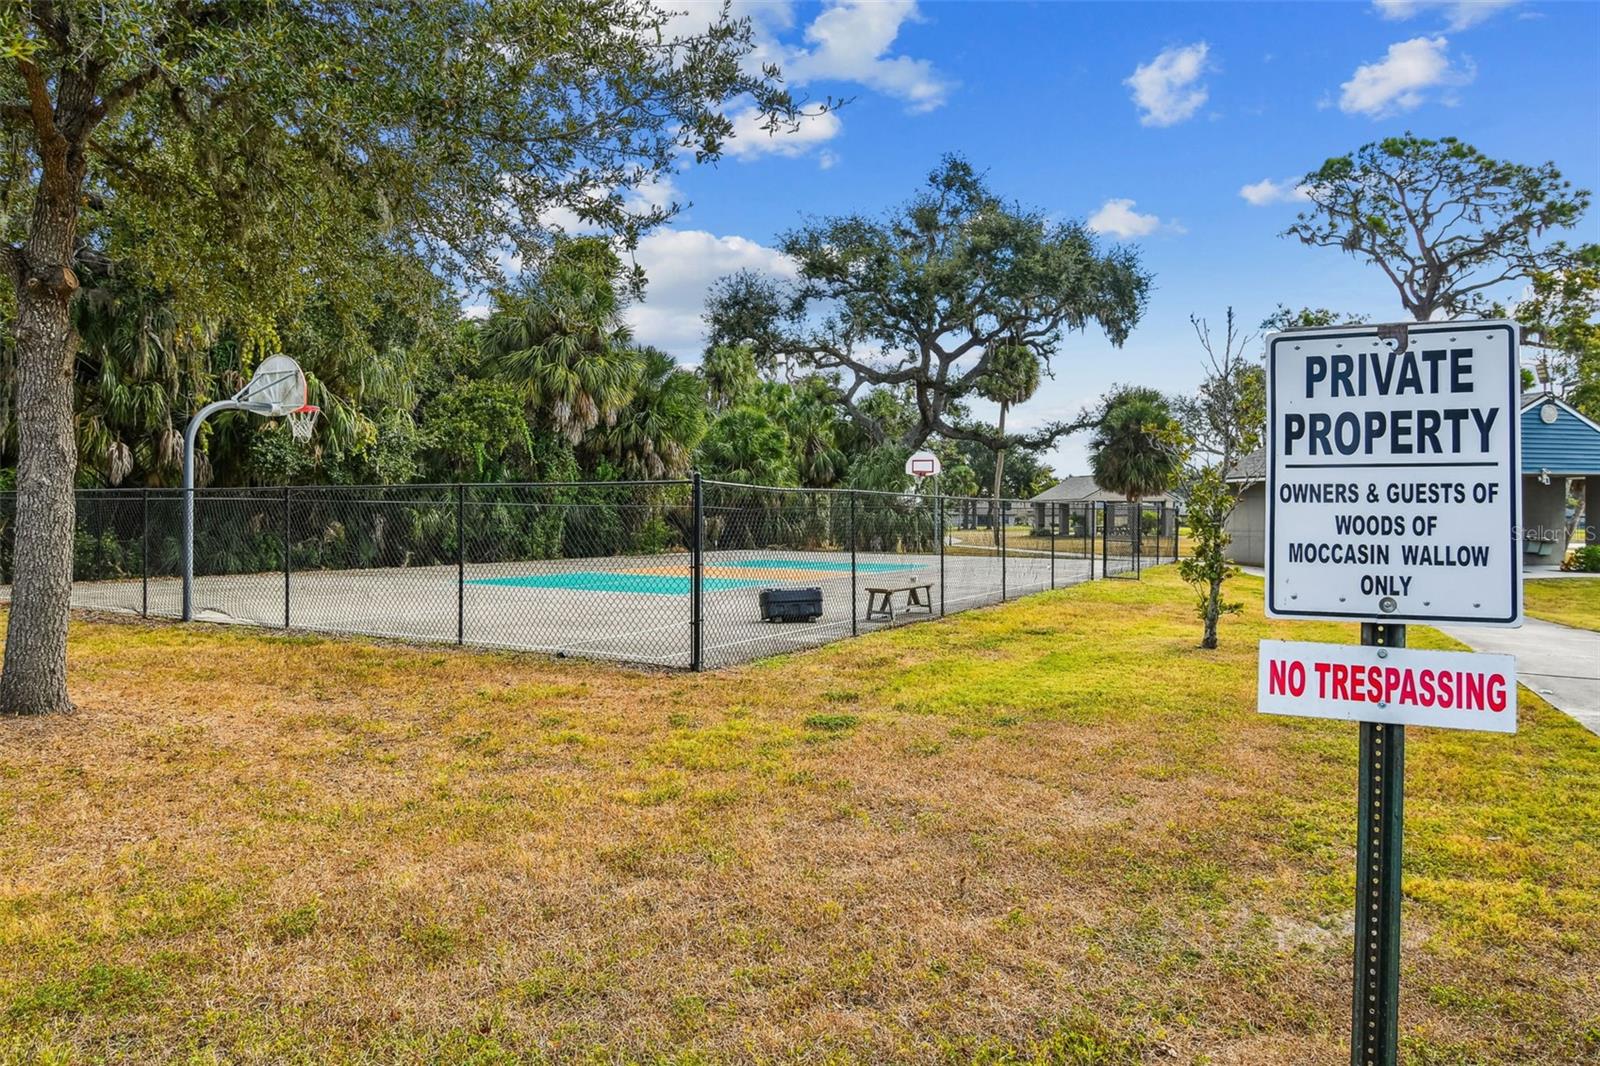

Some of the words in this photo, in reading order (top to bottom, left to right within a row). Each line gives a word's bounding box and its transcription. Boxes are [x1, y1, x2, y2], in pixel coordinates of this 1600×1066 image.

[1305, 348, 1474, 399] PRIVATE
[1284, 407, 1500, 456] PROPERTY
[1279, 483, 1360, 504] OWNERS
[1366, 483, 1380, 504] &
[1386, 482, 1466, 504] GUESTS
[1472, 482, 1499, 504] OF
[1334, 514, 1406, 537] WOODS
[1412, 515, 1438, 537] OF
[1288, 542, 1390, 565] MOCCASIN
[1401, 544, 1490, 567] WALLOW
[1360, 574, 1413, 597] ONLY
[1269, 659, 1306, 698] NO
[1314, 662, 1507, 713] TRESPASSING
